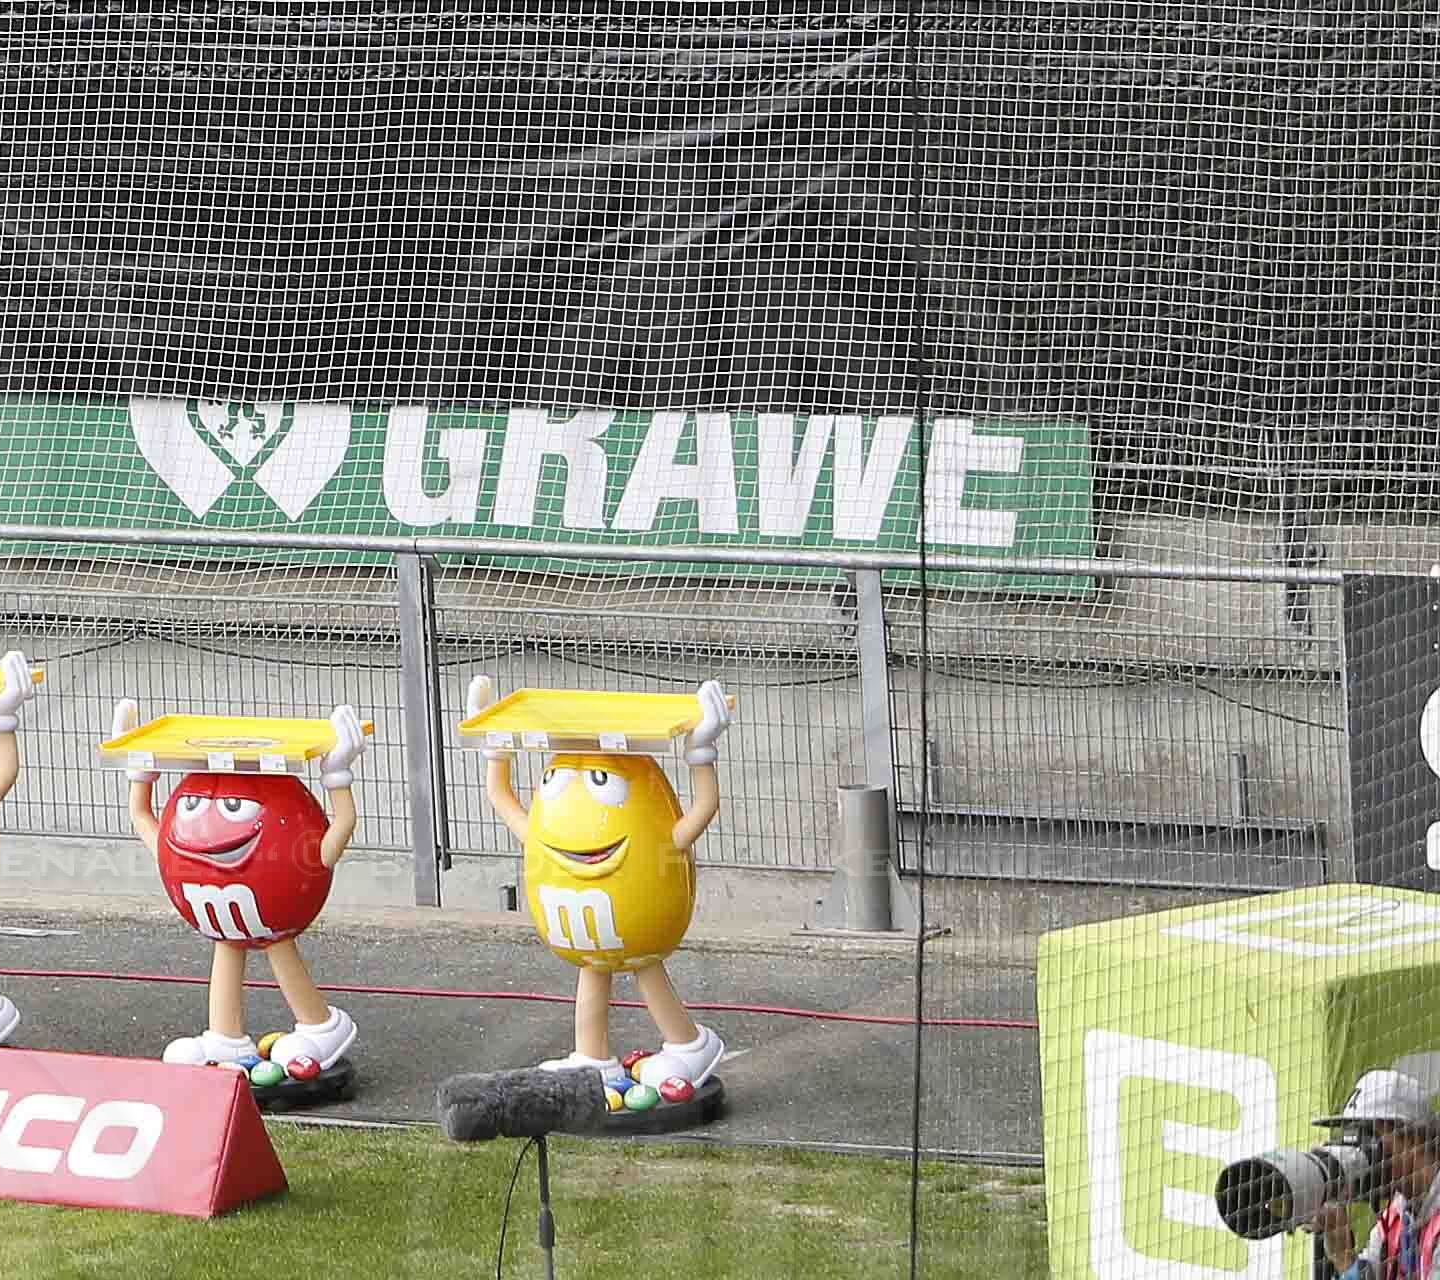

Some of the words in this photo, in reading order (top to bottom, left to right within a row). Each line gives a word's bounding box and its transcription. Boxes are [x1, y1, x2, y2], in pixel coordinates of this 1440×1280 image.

[381, 403, 1026, 548] GRAWE
[182, 883, 272, 940] m
[537, 886, 623, 950] m
